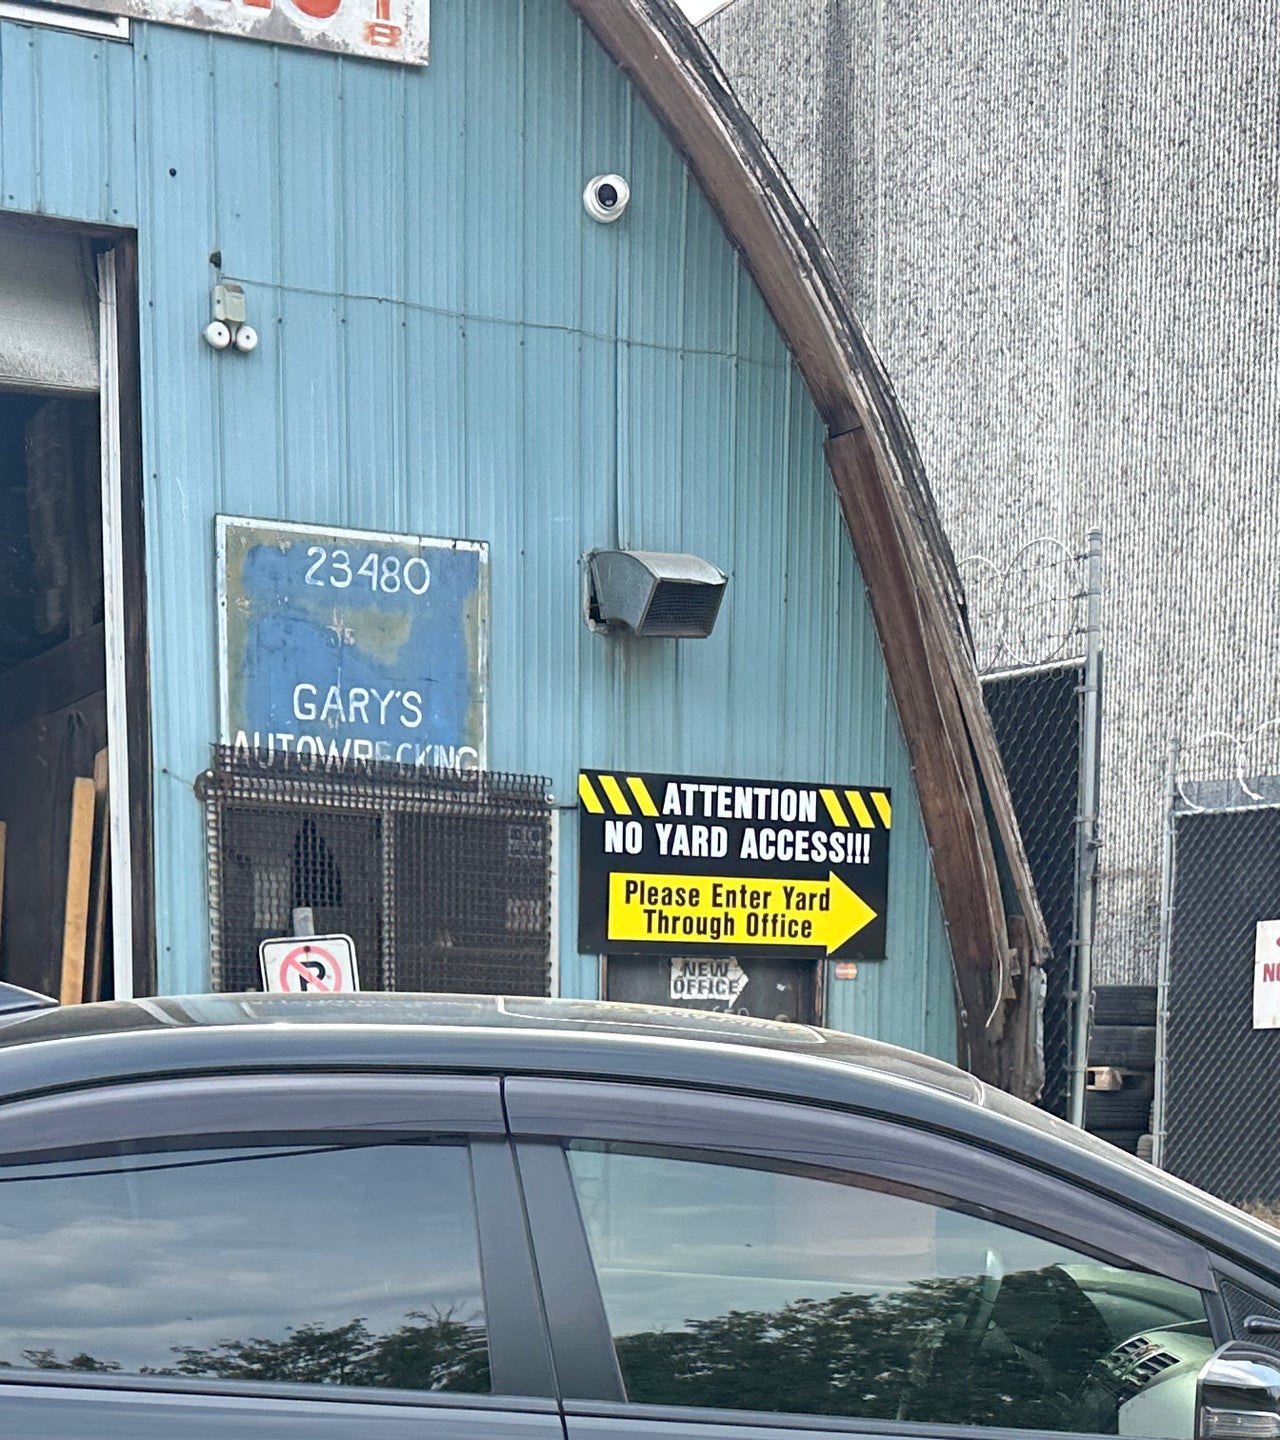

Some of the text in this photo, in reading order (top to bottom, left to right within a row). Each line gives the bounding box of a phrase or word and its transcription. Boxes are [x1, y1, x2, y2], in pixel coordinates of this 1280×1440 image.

[305, 546, 431, 595] 23480
[293, 683, 423, 729] GARY'S
[662, 782, 817, 823] ATTENTION
[604, 820, 871, 865] NO YARD ACCESS!!!
[625, 880, 831, 912] Please Enter Yard
[643, 909, 812, 940] Through Office
[299, 961, 326, 992] P
[683, 960, 729, 977] NEW
[673, 976, 739, 995] OFFICE
